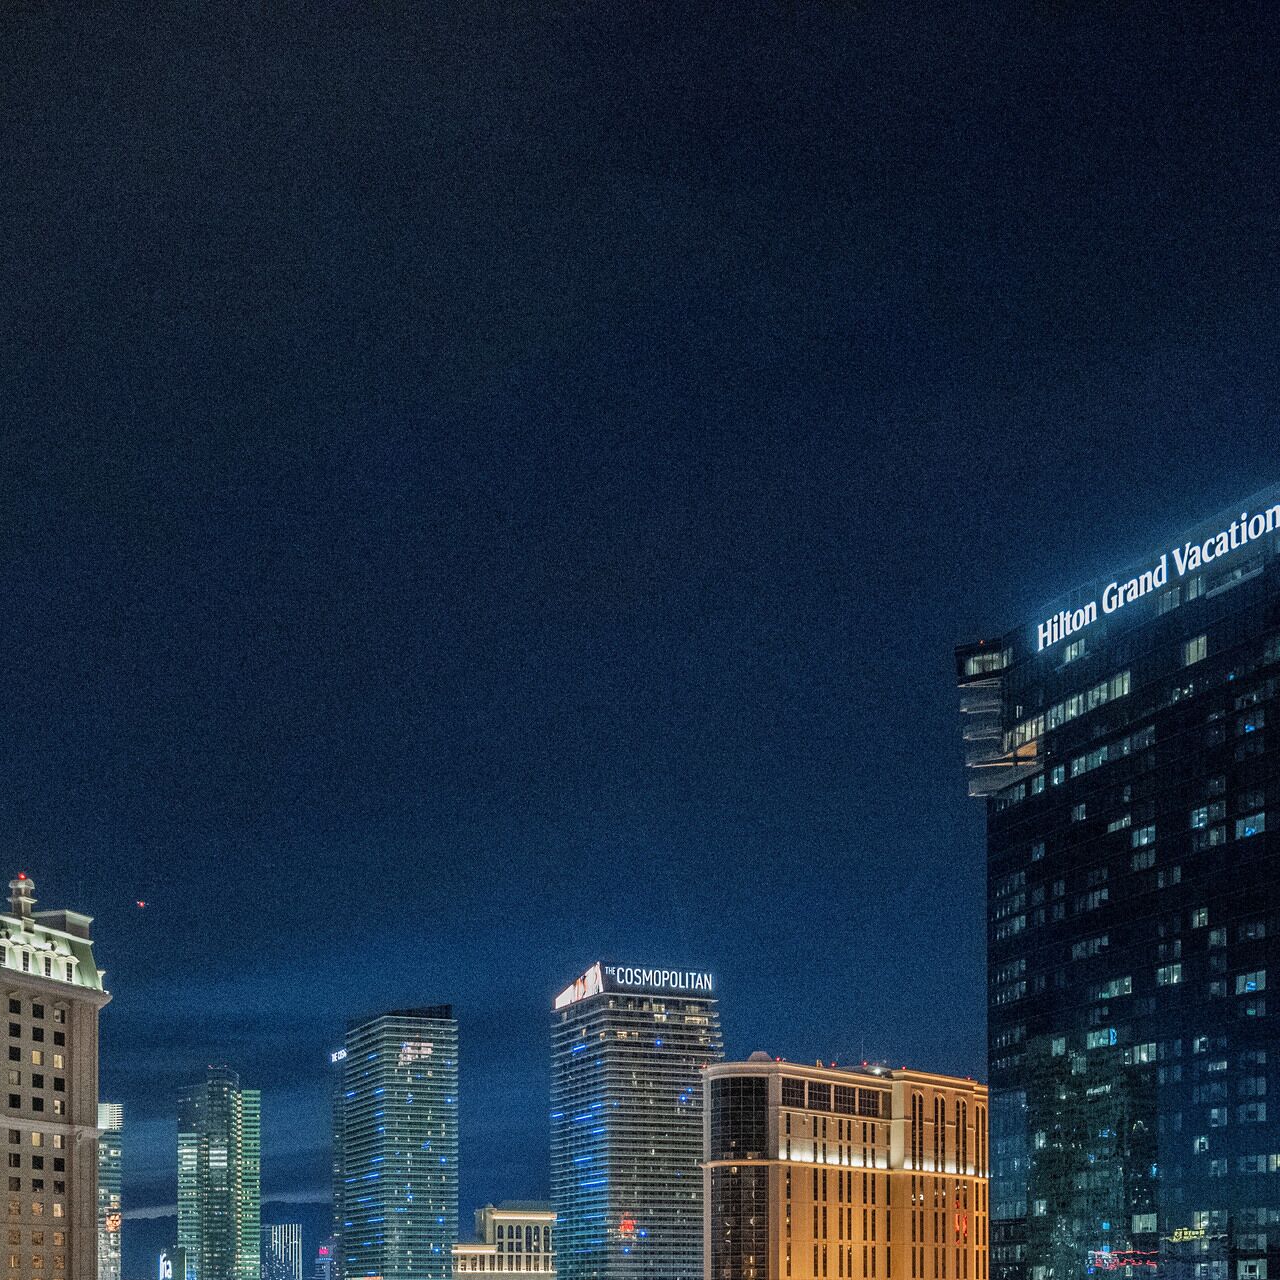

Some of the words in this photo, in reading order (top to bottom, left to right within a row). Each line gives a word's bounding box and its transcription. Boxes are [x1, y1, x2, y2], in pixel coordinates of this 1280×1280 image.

[1037, 601, 1097, 651] Hilton
[1102, 554, 1168, 614] Grand
[605, 966, 616, 975] THE
[616, 967, 713, 990] COSMOPOLITAN
